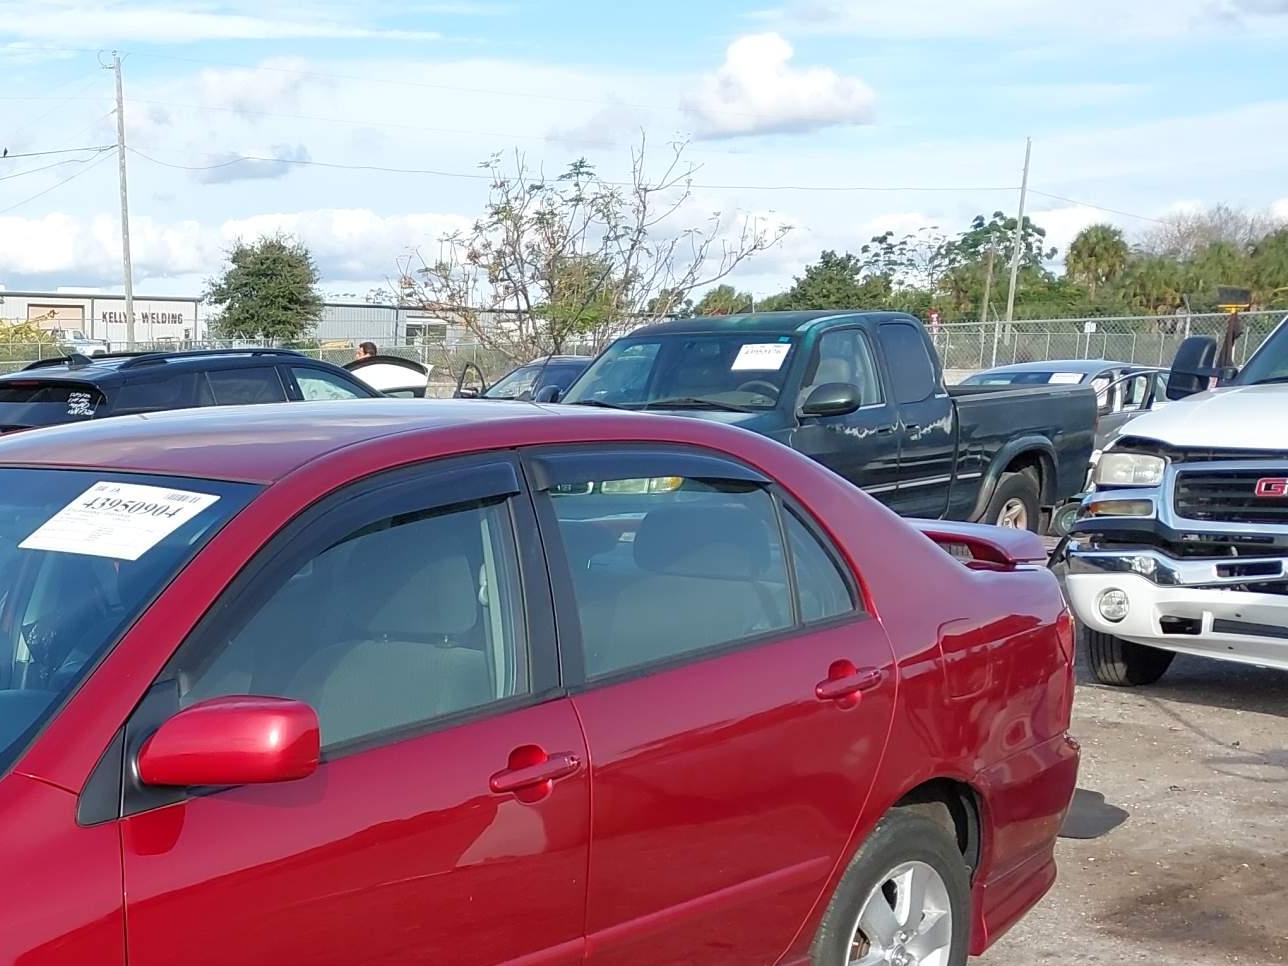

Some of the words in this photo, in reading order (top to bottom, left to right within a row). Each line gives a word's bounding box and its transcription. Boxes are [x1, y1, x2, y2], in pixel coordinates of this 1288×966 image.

[102, 311, 136, 323] KELLYS
[141, 312, 183, 324] WELDING
[82, 497, 184, 518] 43950904
